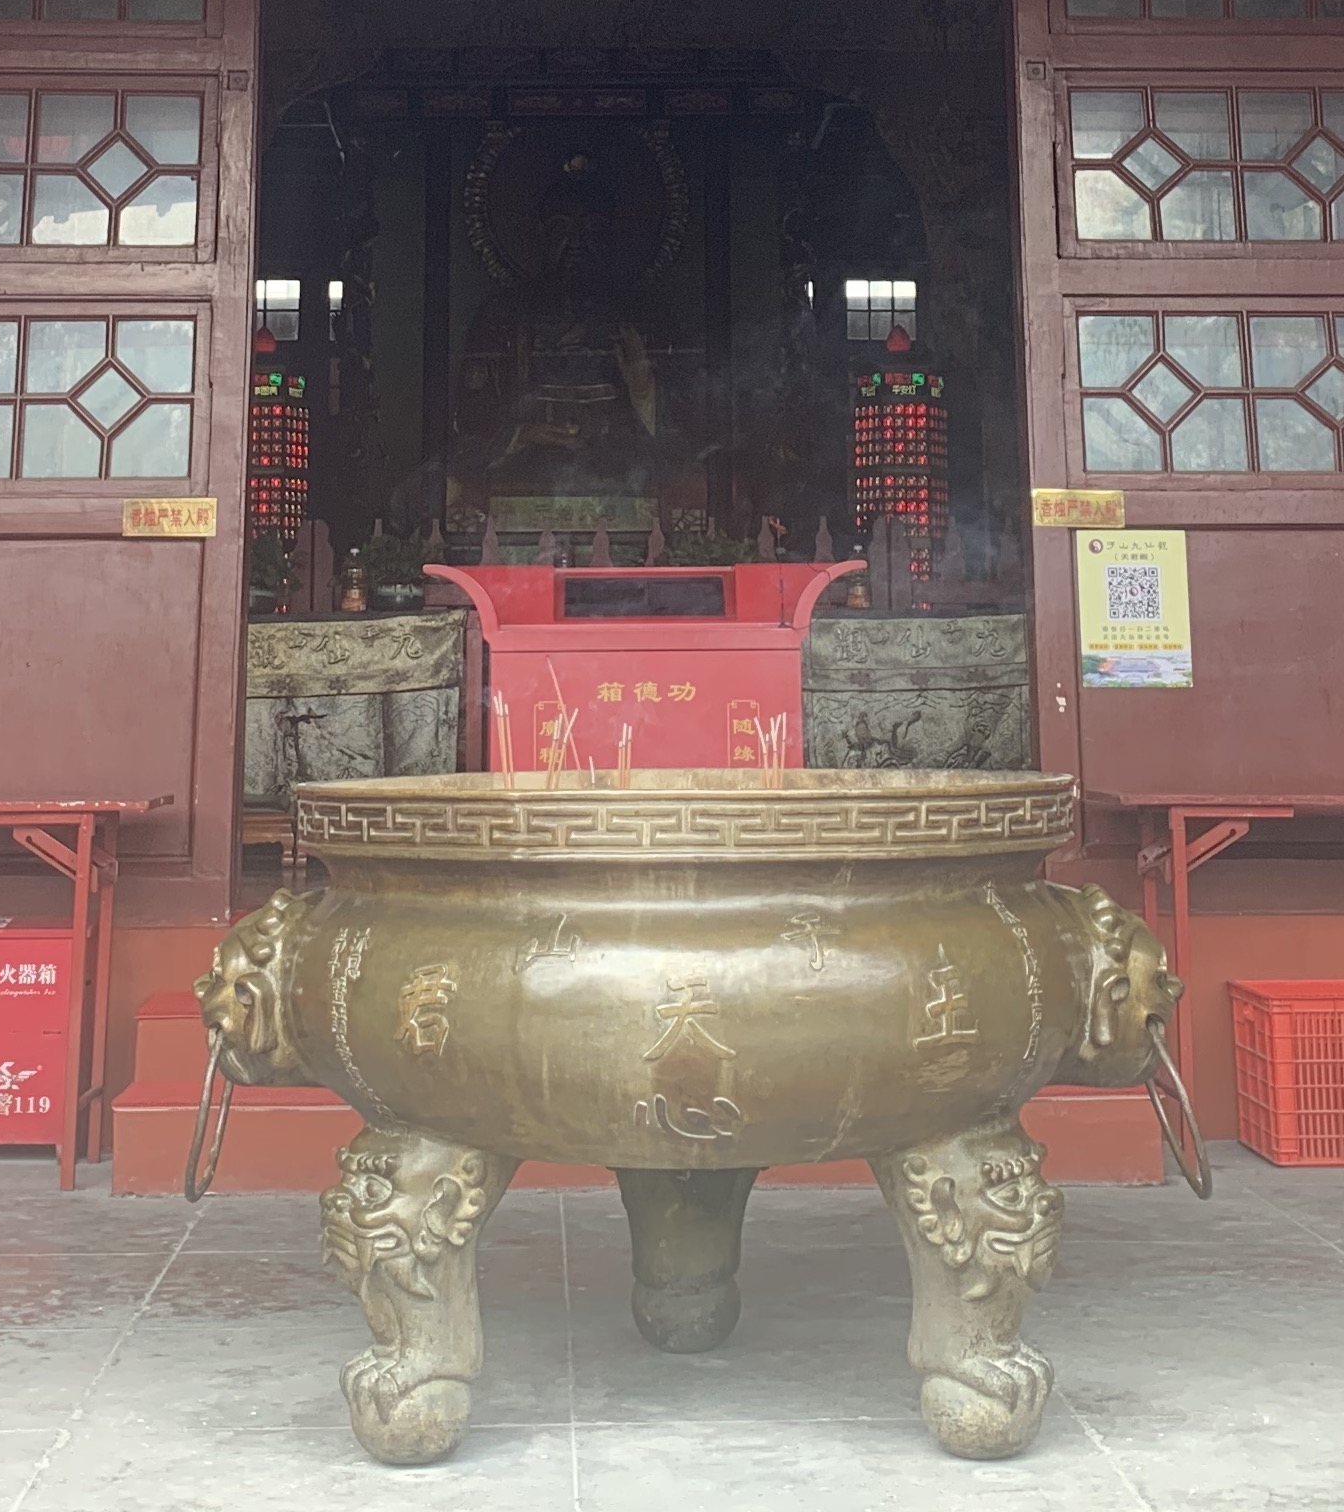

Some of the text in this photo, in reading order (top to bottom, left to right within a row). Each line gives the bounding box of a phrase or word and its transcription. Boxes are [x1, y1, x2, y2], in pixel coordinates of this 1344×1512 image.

[131, 508, 209, 527] 香烛严禁入殿
[1040, 498, 1118, 519] 香烛严禁入殿
[597, 681, 697, 703] 功德箱
